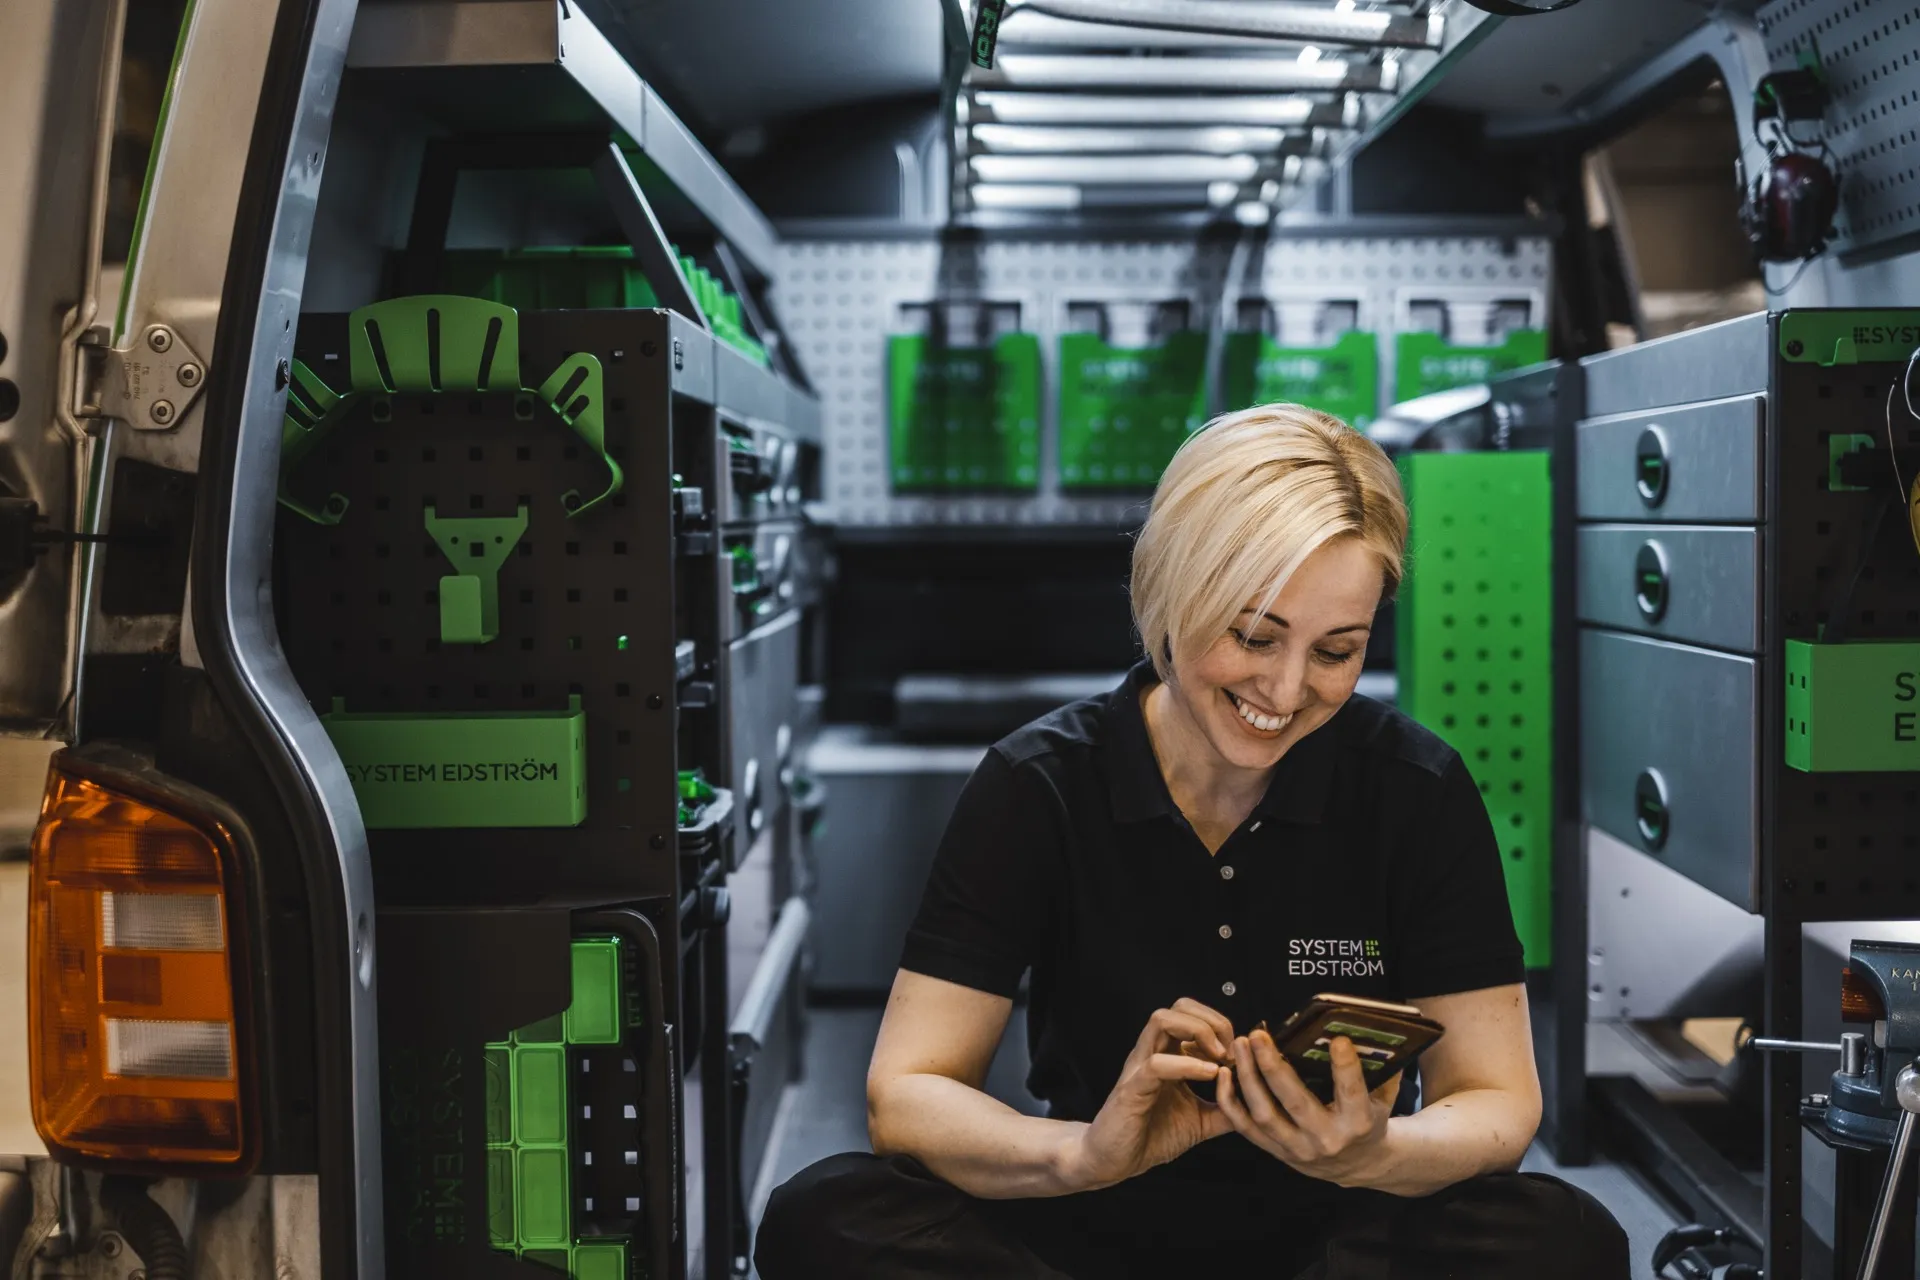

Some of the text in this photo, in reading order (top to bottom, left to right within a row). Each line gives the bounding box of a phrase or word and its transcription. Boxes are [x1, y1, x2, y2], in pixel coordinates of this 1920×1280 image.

[1894, 671, 1920, 702] S
[442, 758, 558, 781] EDSTRÖM
[1289, 939, 1364, 956] SYSTEM
[1288, 957, 1385, 976] EDSTRÖM
